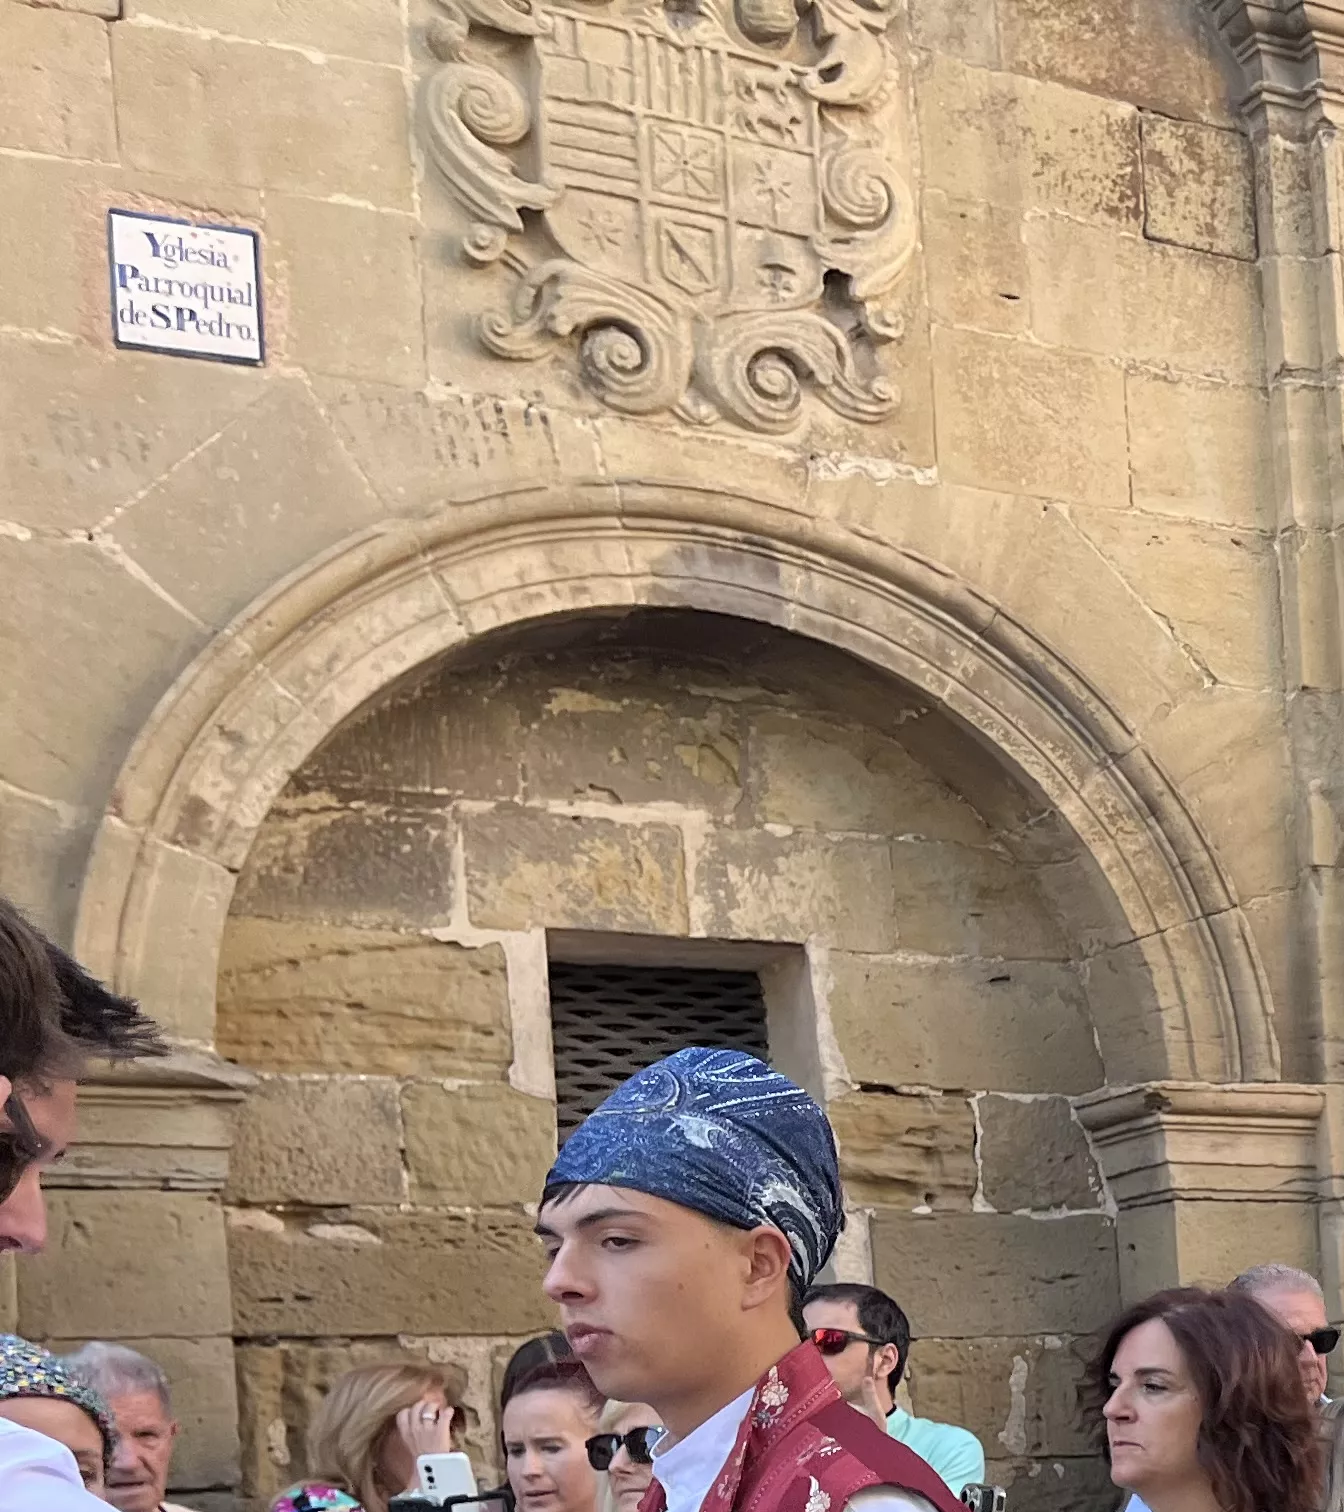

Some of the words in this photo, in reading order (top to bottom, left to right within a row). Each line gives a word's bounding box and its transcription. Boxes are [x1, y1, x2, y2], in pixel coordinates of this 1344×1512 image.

[142, 231, 233, 272] Yglesia
[115, 262, 253, 308] Parroquial
[119, 299, 147, 326] de
